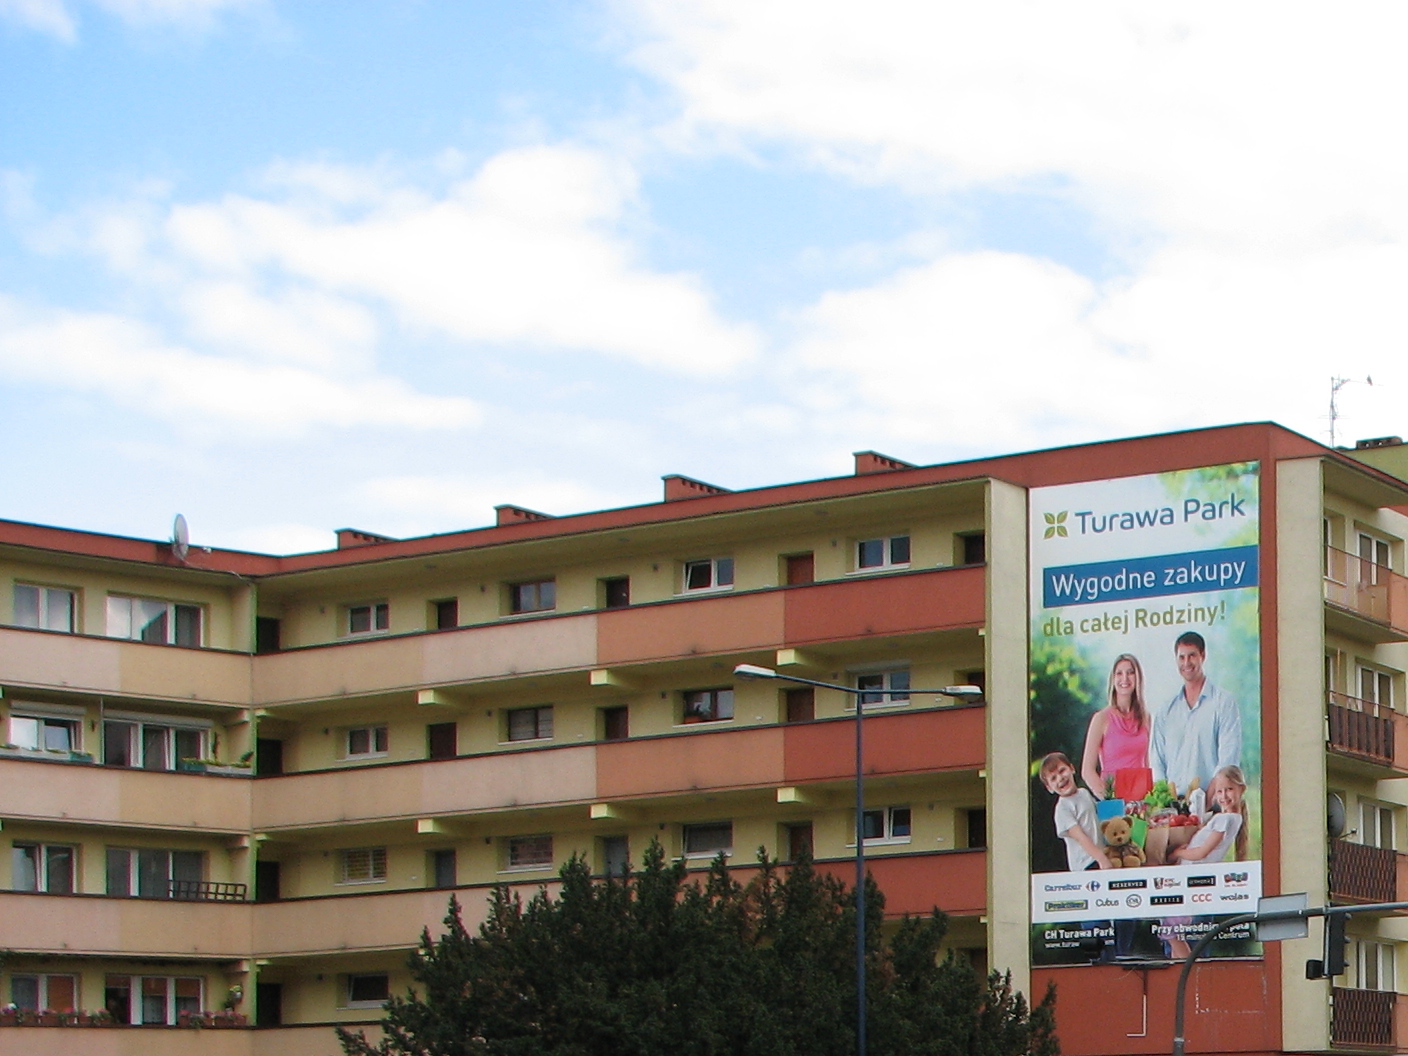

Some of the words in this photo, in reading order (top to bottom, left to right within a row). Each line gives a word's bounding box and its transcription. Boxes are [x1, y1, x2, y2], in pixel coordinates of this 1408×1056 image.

[1074, 507, 1175, 535] Turawa
[1183, 492, 1246, 522] Park
[1051, 567, 1156, 601] Wygodne
[1163, 560, 1246, 586] zakupy
[1043, 616, 1075, 637] dla
[1079, 609, 1129, 634] całej
[1134, 600, 1226, 629] Rodziny!
[1044, 882, 1082, 892] Carrefour
[1111, 881, 1144, 889] RESERVED
[1191, 893, 1213, 902] CCC
[1219, 892, 1250, 901] wojas
[1095, 897, 1119, 908] Cubus
[1044, 930, 1058, 940] CH
[1059, 929, 1092, 939] Turawa
[1093, 927, 1115, 937] Park
[1151, 924, 1172, 935] Przy
[1218, 931, 1251, 940] Centrum
